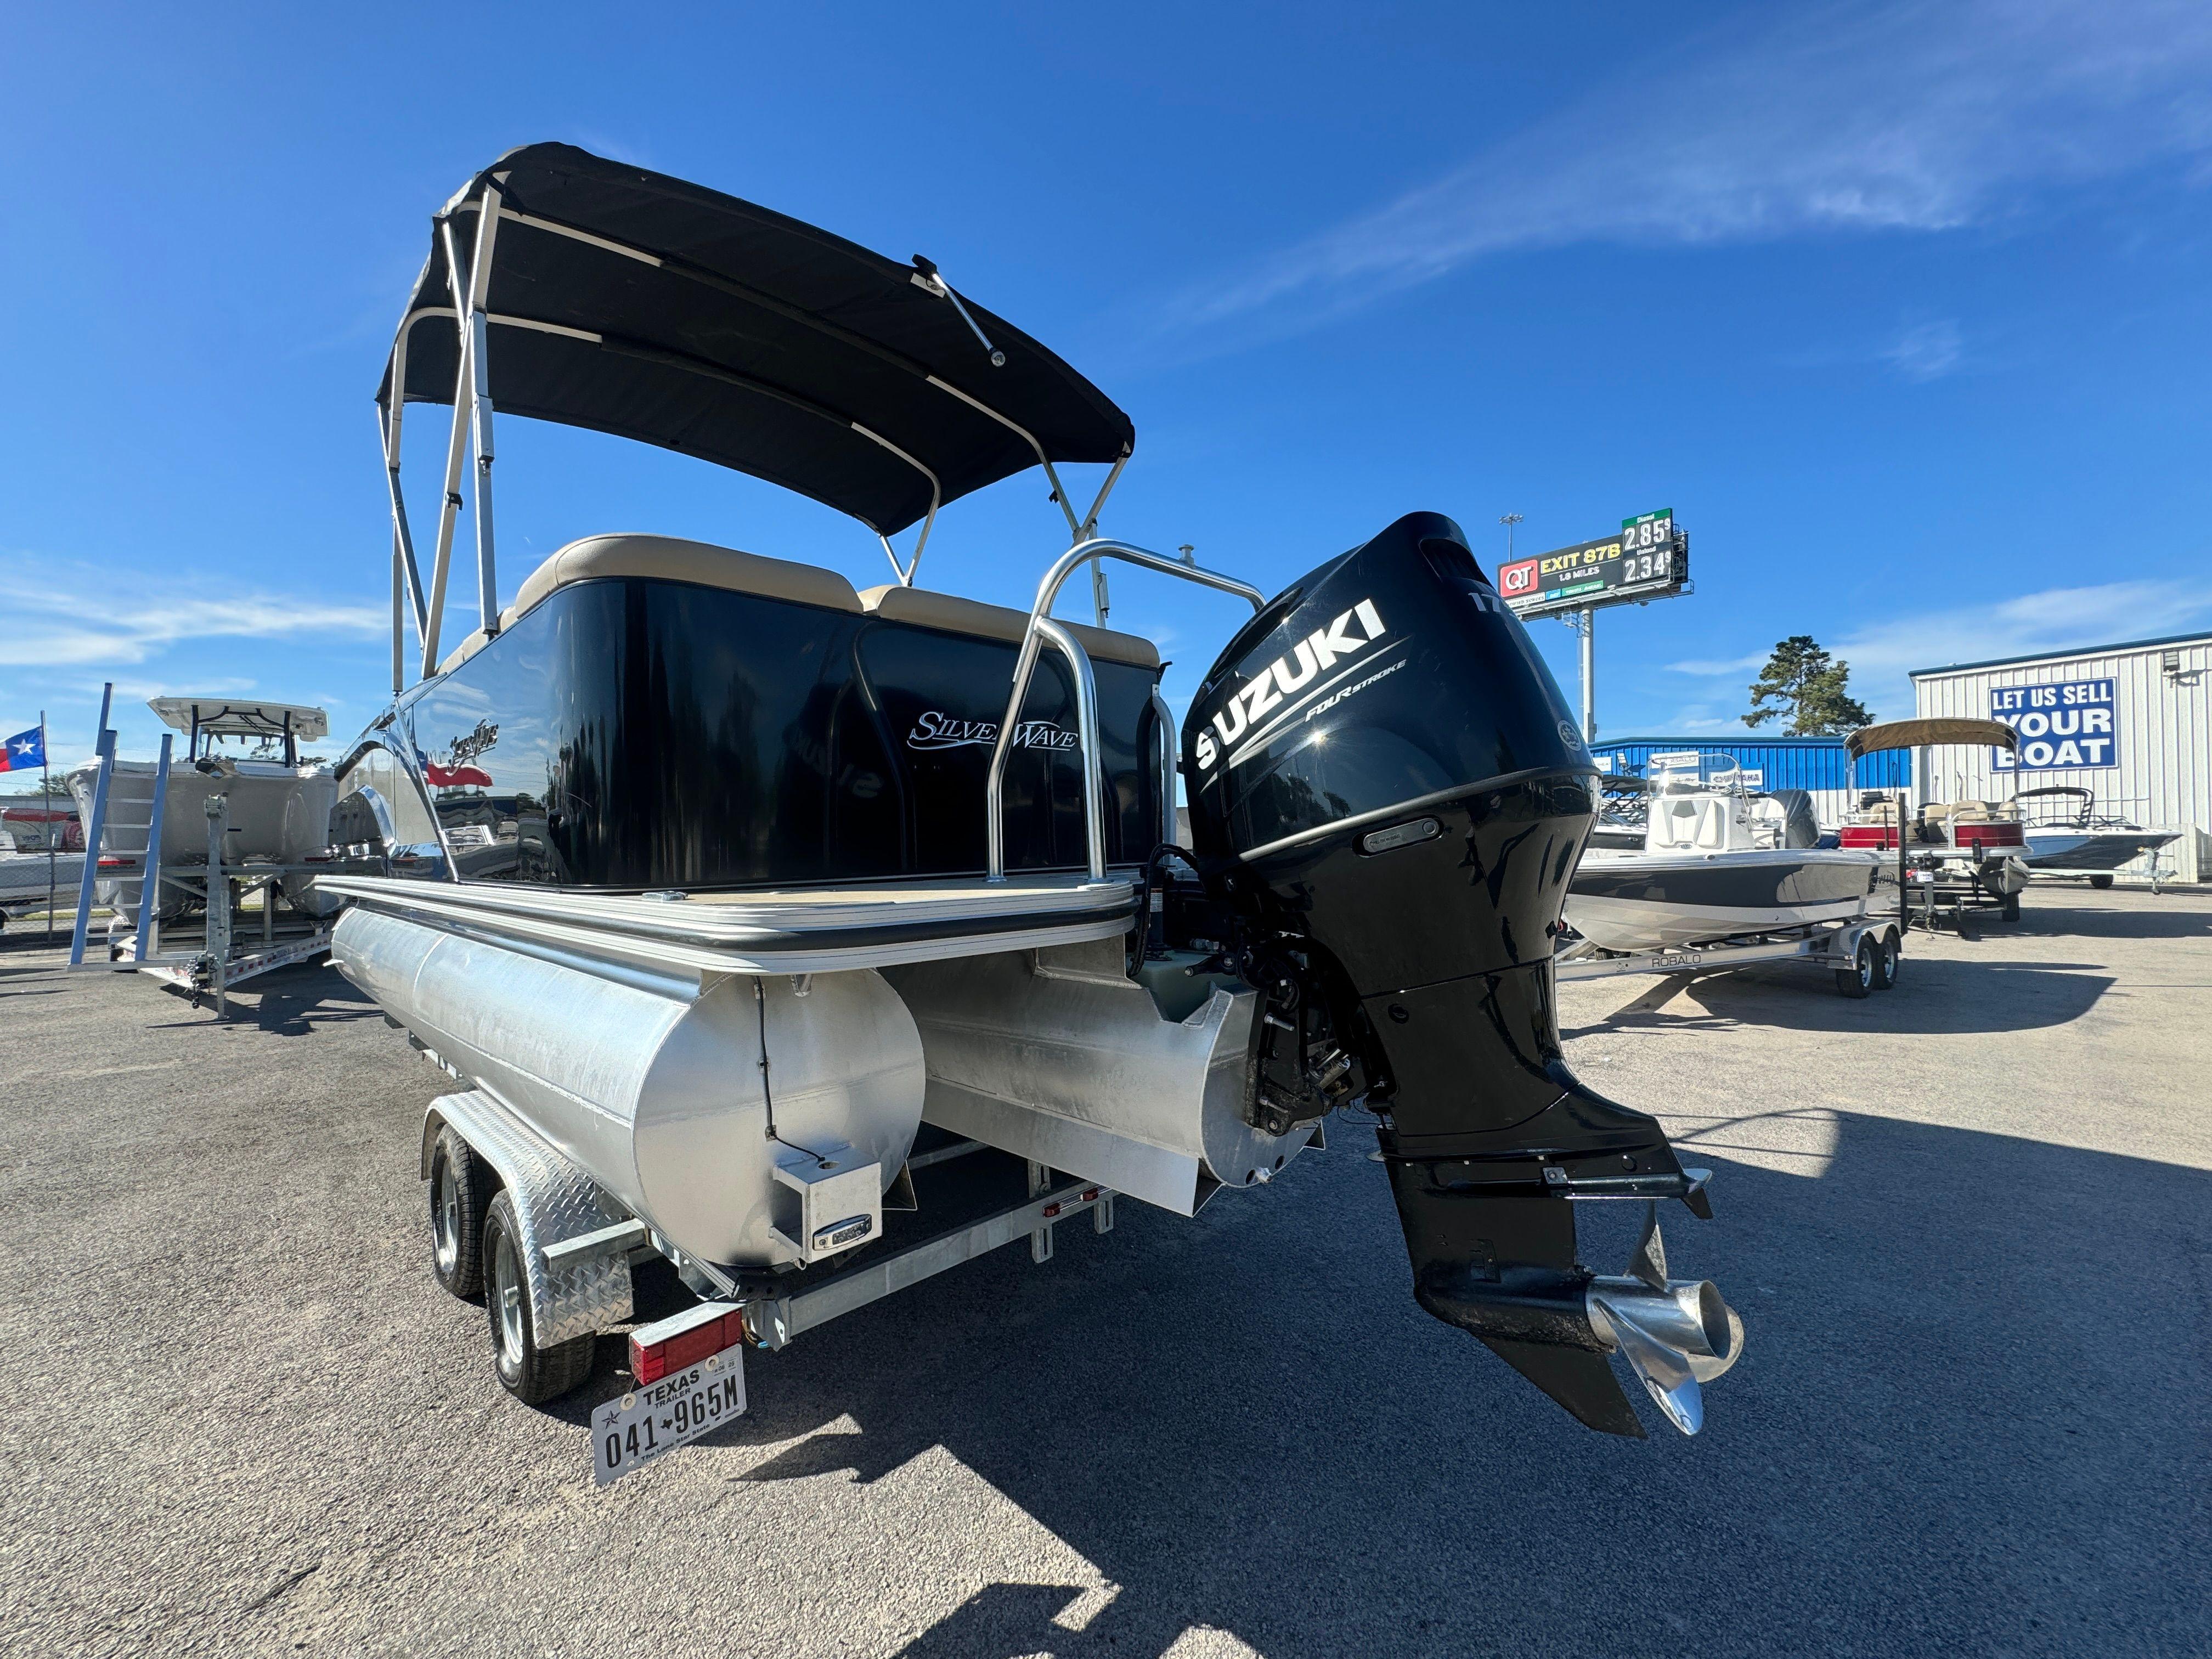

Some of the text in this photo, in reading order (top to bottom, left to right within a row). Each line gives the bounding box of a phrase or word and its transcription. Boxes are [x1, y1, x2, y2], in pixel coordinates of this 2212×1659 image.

[1541, 543, 1621, 574] EXIT 87B
[1573, 566, 1600, 579] MILES
[1505, 566, 1532, 590] QT
[1468, 592, 1501, 613] 17
[1196, 598, 1386, 770] SUZUKI
[1992, 682, 2112, 710] LET US SELL
[909, 711, 1079, 749] SILVE WAVE
[1994, 708, 2112, 737] YOUR
[1996, 738, 2111, 768] BOAT
[1652, 955, 1701, 968] ROBALO
[643, 1369, 699, 1406] TEXAS
[654, 1387, 691, 1409] TRAILER
[606, 1374, 738, 1468] 041 965M
[641, 1424, 710, 1461] The Lone Star State
